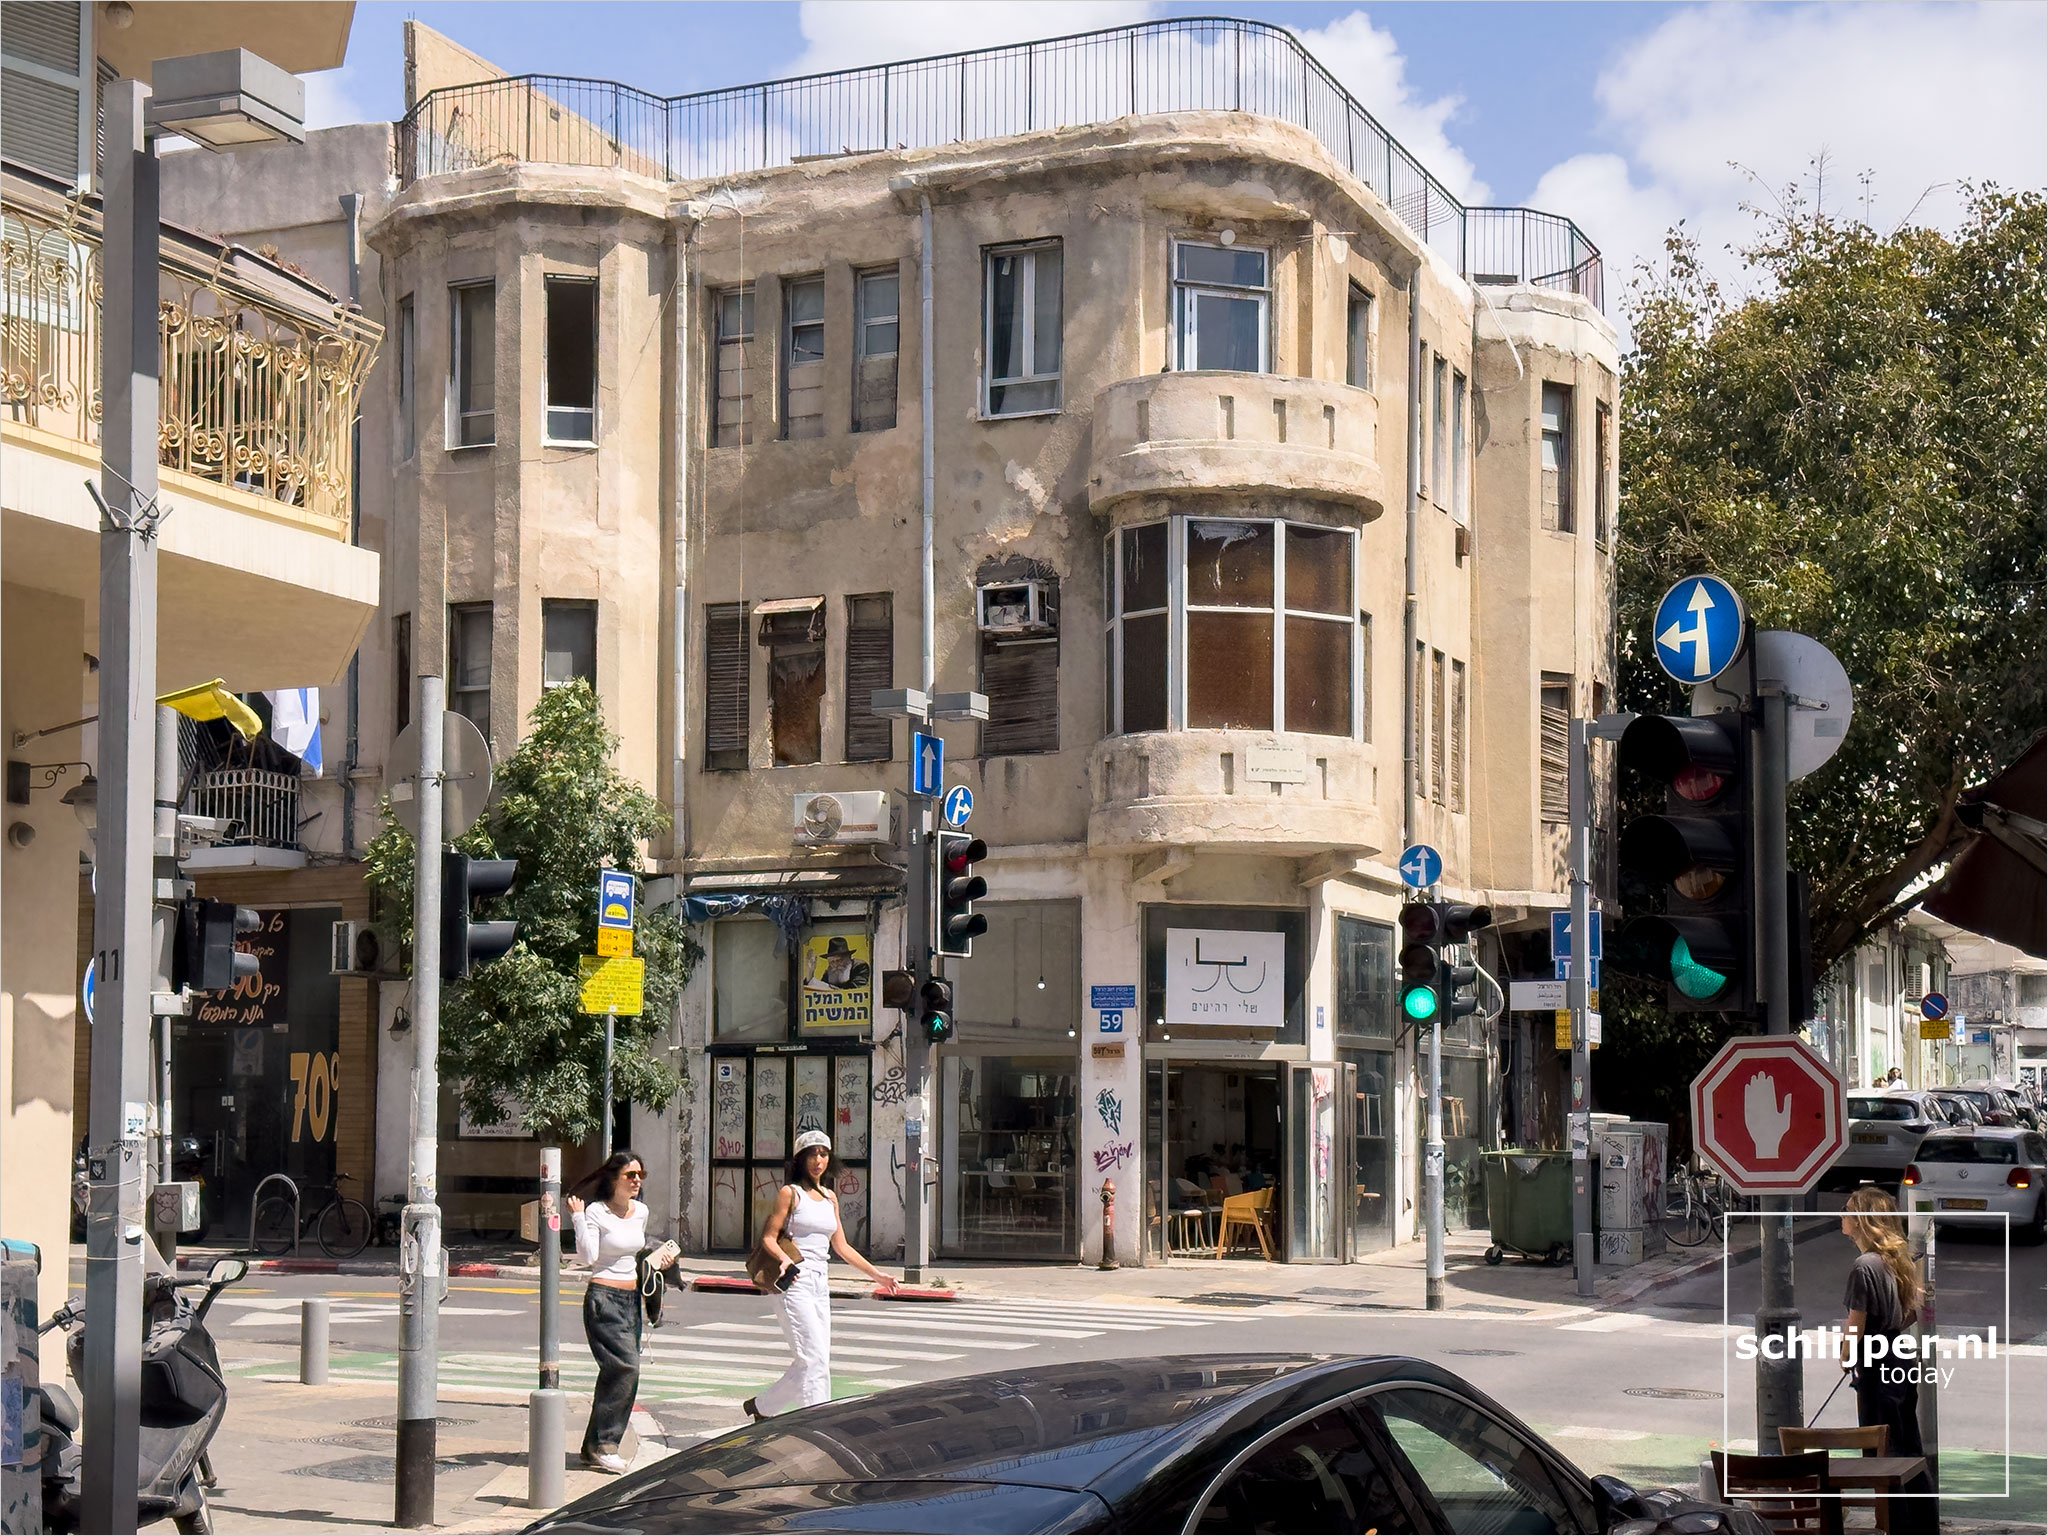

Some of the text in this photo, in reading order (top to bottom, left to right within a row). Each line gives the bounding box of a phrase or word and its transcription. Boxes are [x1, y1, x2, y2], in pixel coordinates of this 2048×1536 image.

[99, 949, 120, 982] 11
[263, 983, 281, 1005] רק
[805, 991, 868, 1008] יחי המלך
[197, 1001, 264, 1025] חנות המפעל
[805, 1005, 869, 1022] המשיח
[1191, 1000, 1258, 1014] שלי רהיטים
[1101, 1014, 1122, 1030] 59
[1572, 1041, 1584, 1054] 12
[290, 1051, 340, 1142] 70
